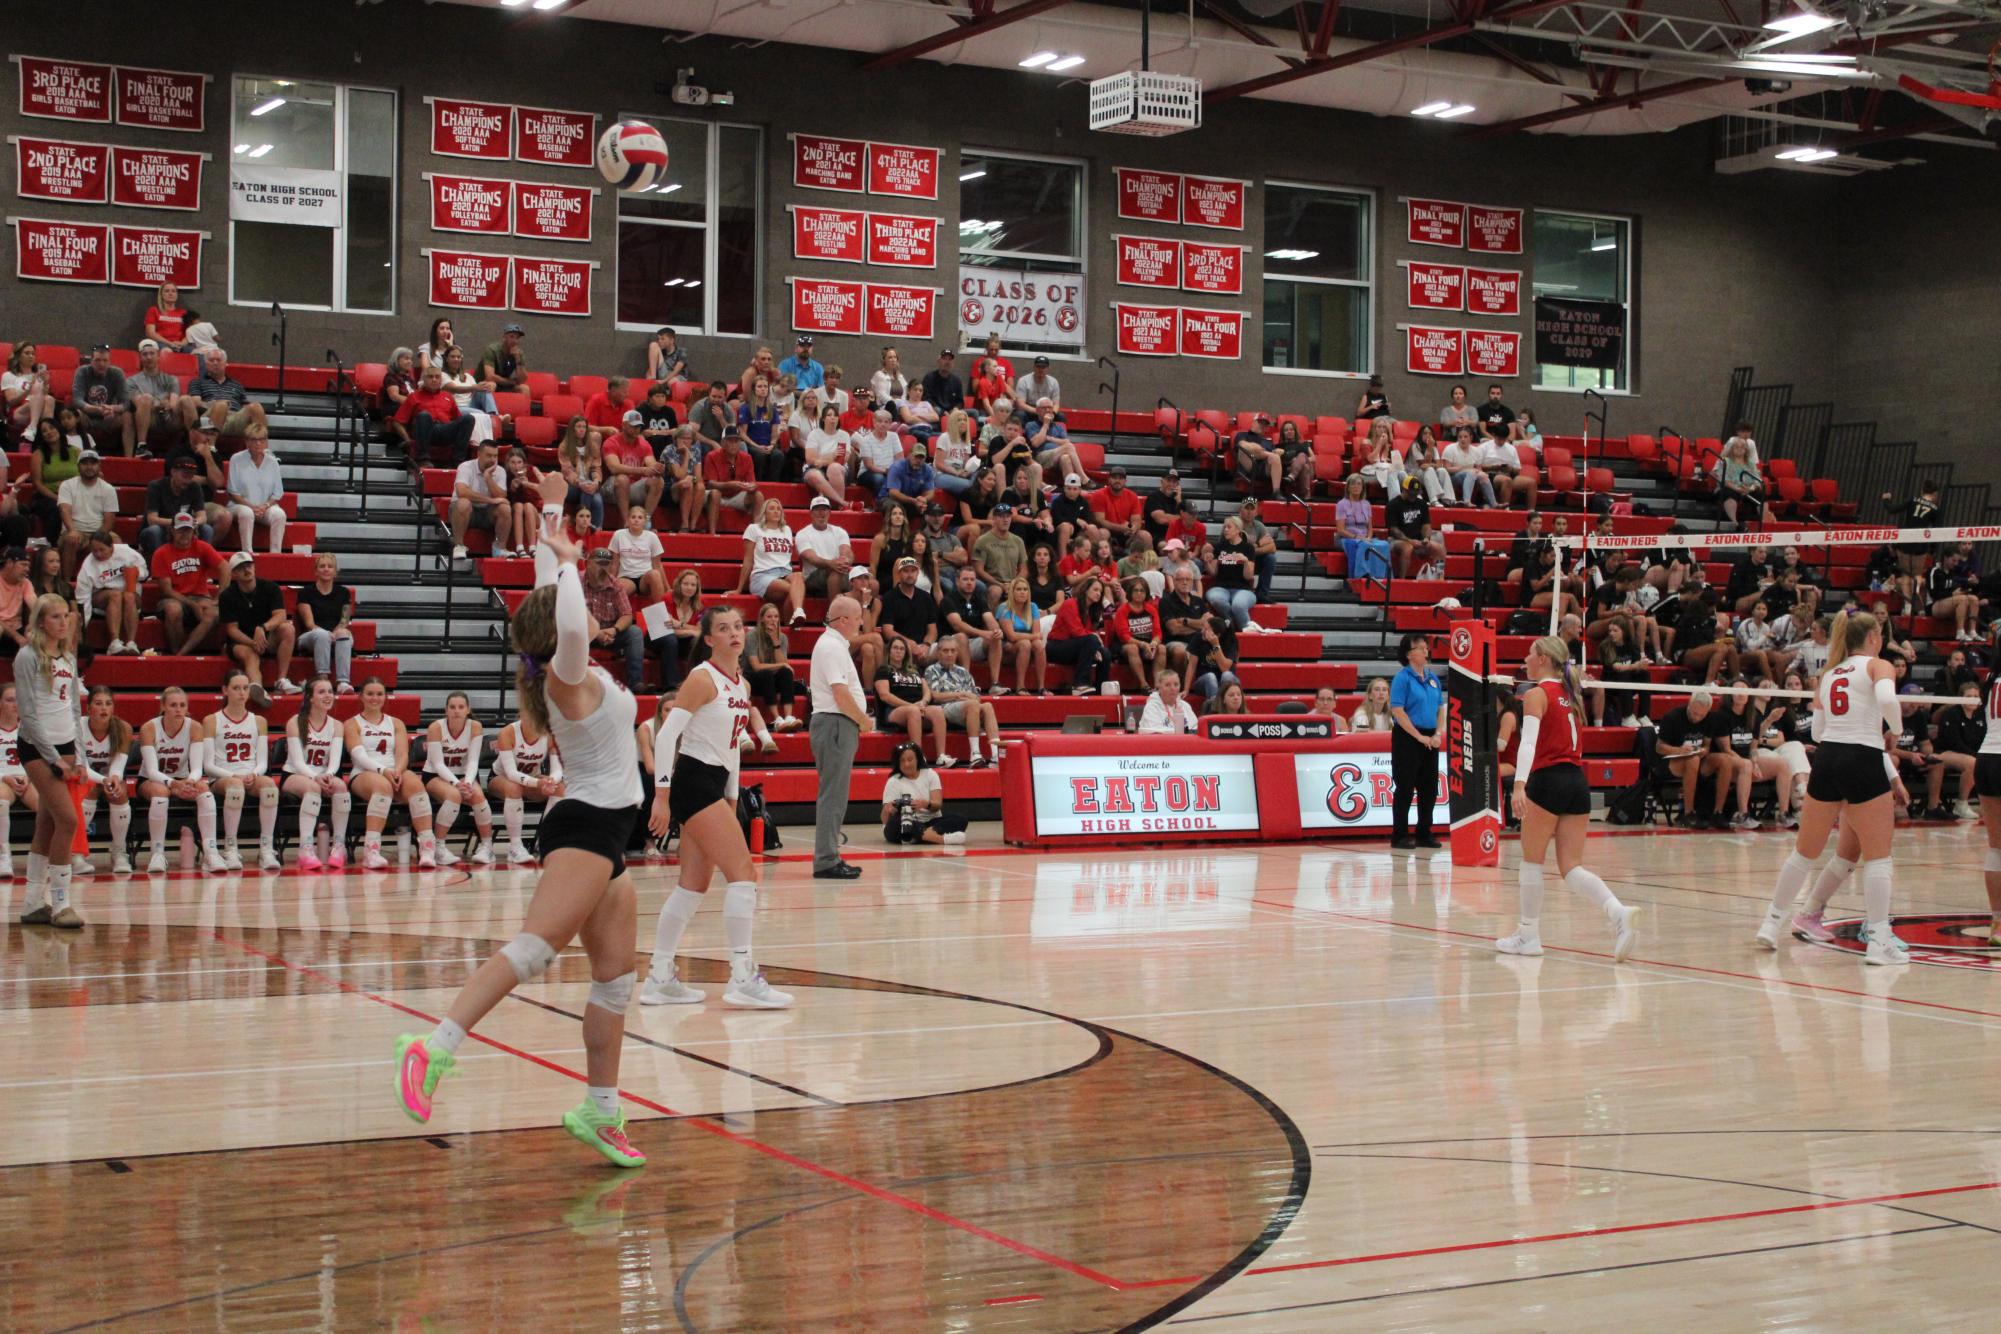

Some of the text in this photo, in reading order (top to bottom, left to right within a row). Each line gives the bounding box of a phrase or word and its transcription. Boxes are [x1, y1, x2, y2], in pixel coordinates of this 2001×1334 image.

[52, 66, 80, 77] STATE
[32, 70, 100, 94] 3RD PLACE
[147, 76, 173, 86] STATE
[46, 87, 86, 99] 2019 AAA
[127, 80, 193, 102] FINAL FOUR
[32, 94, 100, 109] GIRLS BASKETBALL
[139, 96, 180, 108] 2020 AAA
[126, 103, 193, 118] GIRLS BASKETBALL
[459, 107, 484, 116] STATE
[441, 110, 502, 132] CHAMPIONS
[542, 115, 566, 124] STATE
[453, 127, 490, 137] 2020 AAA
[525, 118, 584, 139] CHAMPIONS
[537, 135, 571, 145] 2021 AAA
[48, 146, 76, 157] STATE
[803, 146, 856, 166] 2ND PLACE
[28, 150, 96, 174] 2ND PLACE
[142, 155, 169, 165] STATE
[878, 154, 930, 174] 4TH PLACE
[41, 167, 82, 179] 2019 AAA
[122, 159, 189, 181] CHAMPIONS
[41, 176, 82, 188] WRESTLING
[135, 176, 176, 187] 2020 AAA
[459, 183, 483, 192] STATE
[1127, 178, 1173, 198] CHAMPIONS
[136, 185, 176, 195] WRESTLING
[232, 182, 338, 198] EATON HIGH SCHOOL
[441, 186, 502, 207] CHAMPIONS
[540, 190, 564, 198] STATE
[1190, 185, 1236, 204] CHAMPIONS
[246, 194, 324, 207] CLASS OF 2027
[452, 203, 489, 213] 2020 AAA
[523, 193, 581, 214] CHAMPIONS
[537, 210, 554, 218] 2021
[1414, 207, 1459, 224] FINAL FOUR
[803, 216, 856, 236] CHAMPIONS
[1474, 215, 1515, 230] CHAMPIONS
[49, 228, 76, 237] STATE
[142, 235, 169, 244] STATE
[875, 224, 930, 242] THIRD PLACE
[28, 233, 97, 254] FINAL FOUR
[123, 238, 190, 259] CHAMPIONS
[42, 249, 82, 259] 2019 AAA
[138, 255, 174, 266] 2020 AA
[1125, 245, 1172, 264] FINAL FOUR
[1188, 252, 1233, 270] 3RD PLACE
[44, 258, 81, 268] BASEBALL
[138, 264, 173, 274] FOOTBALL
[458, 258, 481, 267] STATE
[540, 264, 564, 273] STATE
[440, 262, 500, 282] RUNNER UP
[523, 268, 581, 288] FINAL FOUR
[1413, 272, 1459, 287] FINAL FOUR
[452, 278, 486, 288] 2021 AAA
[535, 283, 568, 293] 2021 AAA
[1470, 278, 1516, 292] FINAL FOUR
[802, 289, 854, 308] CHAMPIONS
[961, 278, 1078, 304] CLASS OF
[874, 293, 926, 312] CHAMPIONS
[992, 305, 1047, 326] 2026
[1123, 314, 1171, 330] CHAMPIONS
[1186, 318, 1236, 335] FINAL FOUR
[1574, 324, 1621, 336] SCHOOL
[1414, 335, 1457, 351] CHAMPIONS
[1471, 338, 1513, 354] FINAL FOUR
[1550, 334, 1587, 345] CLASS
[1913, 504, 1932, 518] 17
[1705, 534, 1772, 544] EATON REDS
[1824, 530, 1899, 541] EATON REDS
[1956, 528, 2000, 538] EATON
[1597, 537, 1658, 547] EATON REDS
[172, 558, 200, 570] EATON
[1830, 678, 1849, 716] 6
[1259, 725, 1280, 736] POSS
[226, 743, 250, 762] 22
[376, 739, 386, 754] 4
[1449, 696, 1463, 796] EATON
[1463, 720, 1473, 774] REDS
[307, 749, 325, 766] 16
[1118, 760, 1170, 770] Welcome to
[1070, 775, 1220, 814] EATON
[1081, 817, 1217, 832] HIGH SCHOOL
